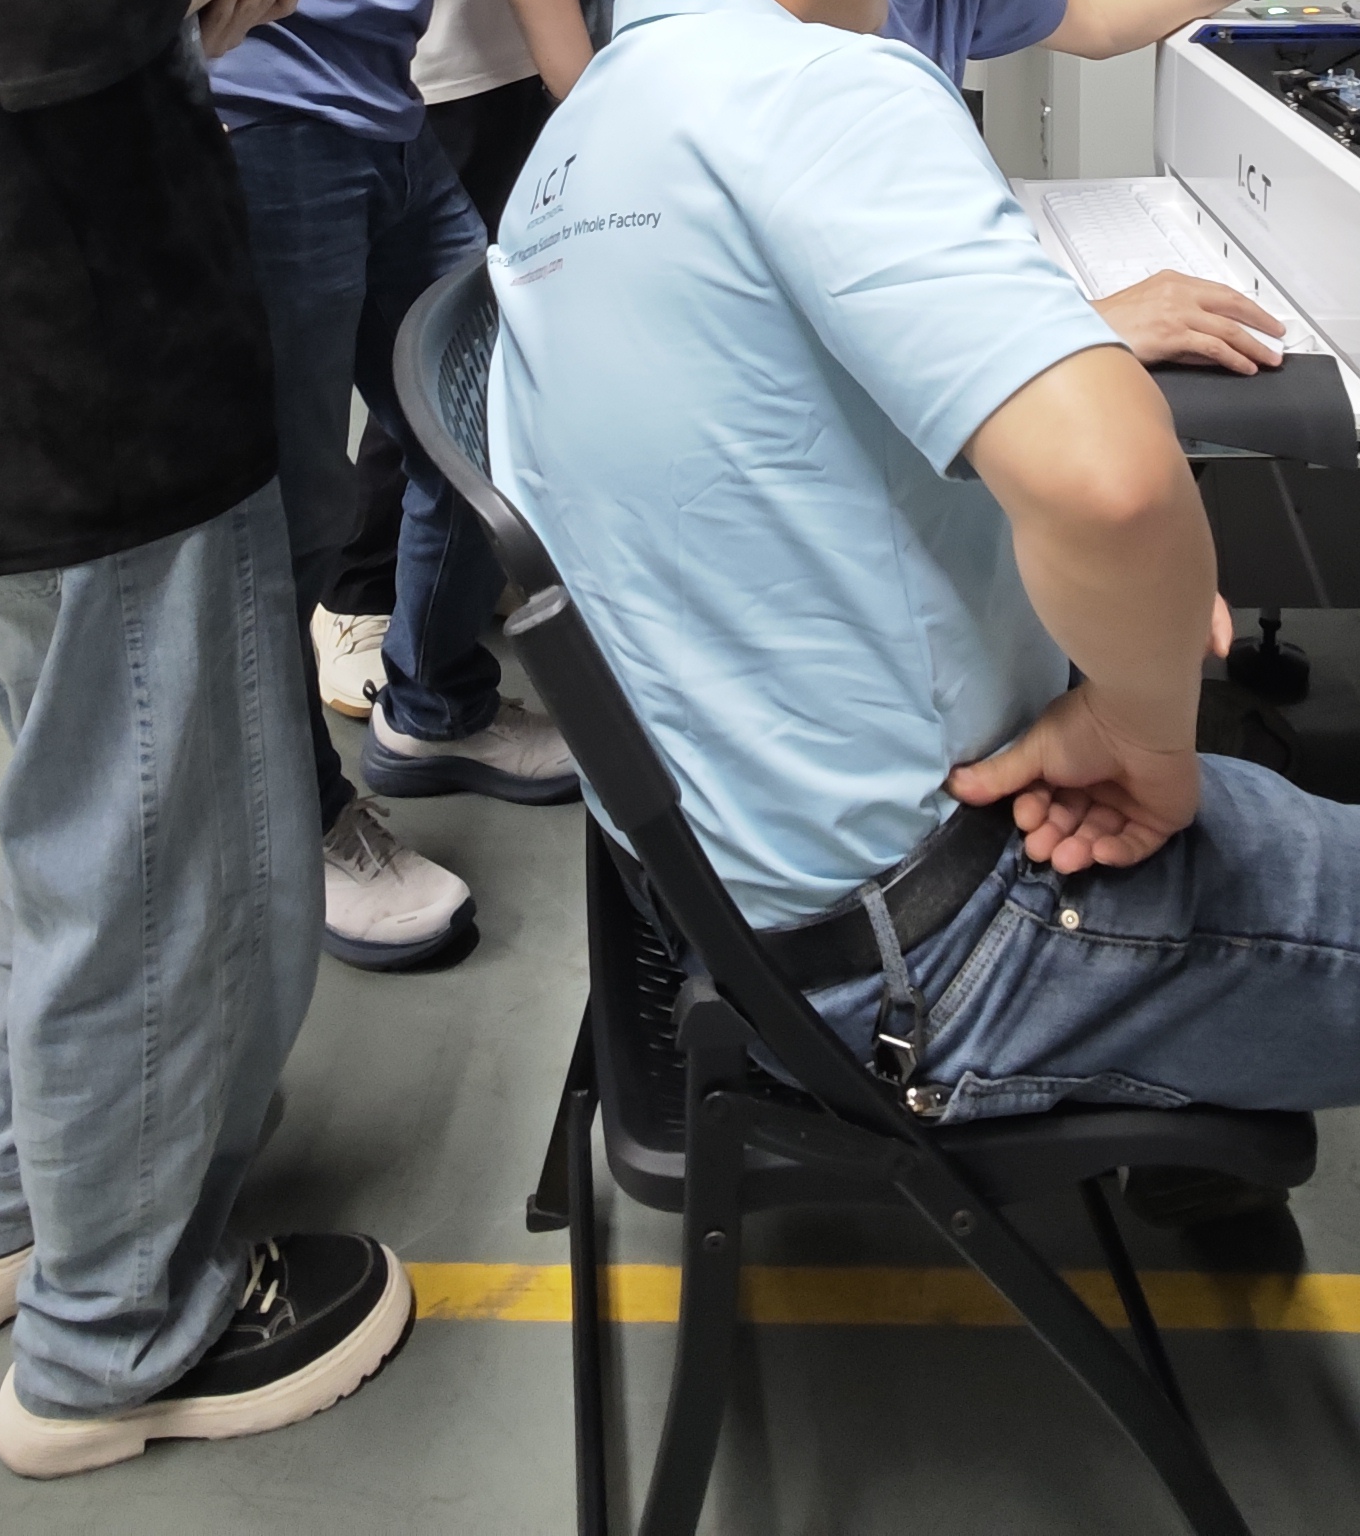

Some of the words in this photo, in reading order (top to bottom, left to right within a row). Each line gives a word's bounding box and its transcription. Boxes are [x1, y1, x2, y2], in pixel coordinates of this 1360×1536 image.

[530, 153, 578, 215] I.C.T
[1238, 153, 1272, 213] I.C.T
[574, 215, 606, 236] Whole
[608, 211, 662, 229] Factory
